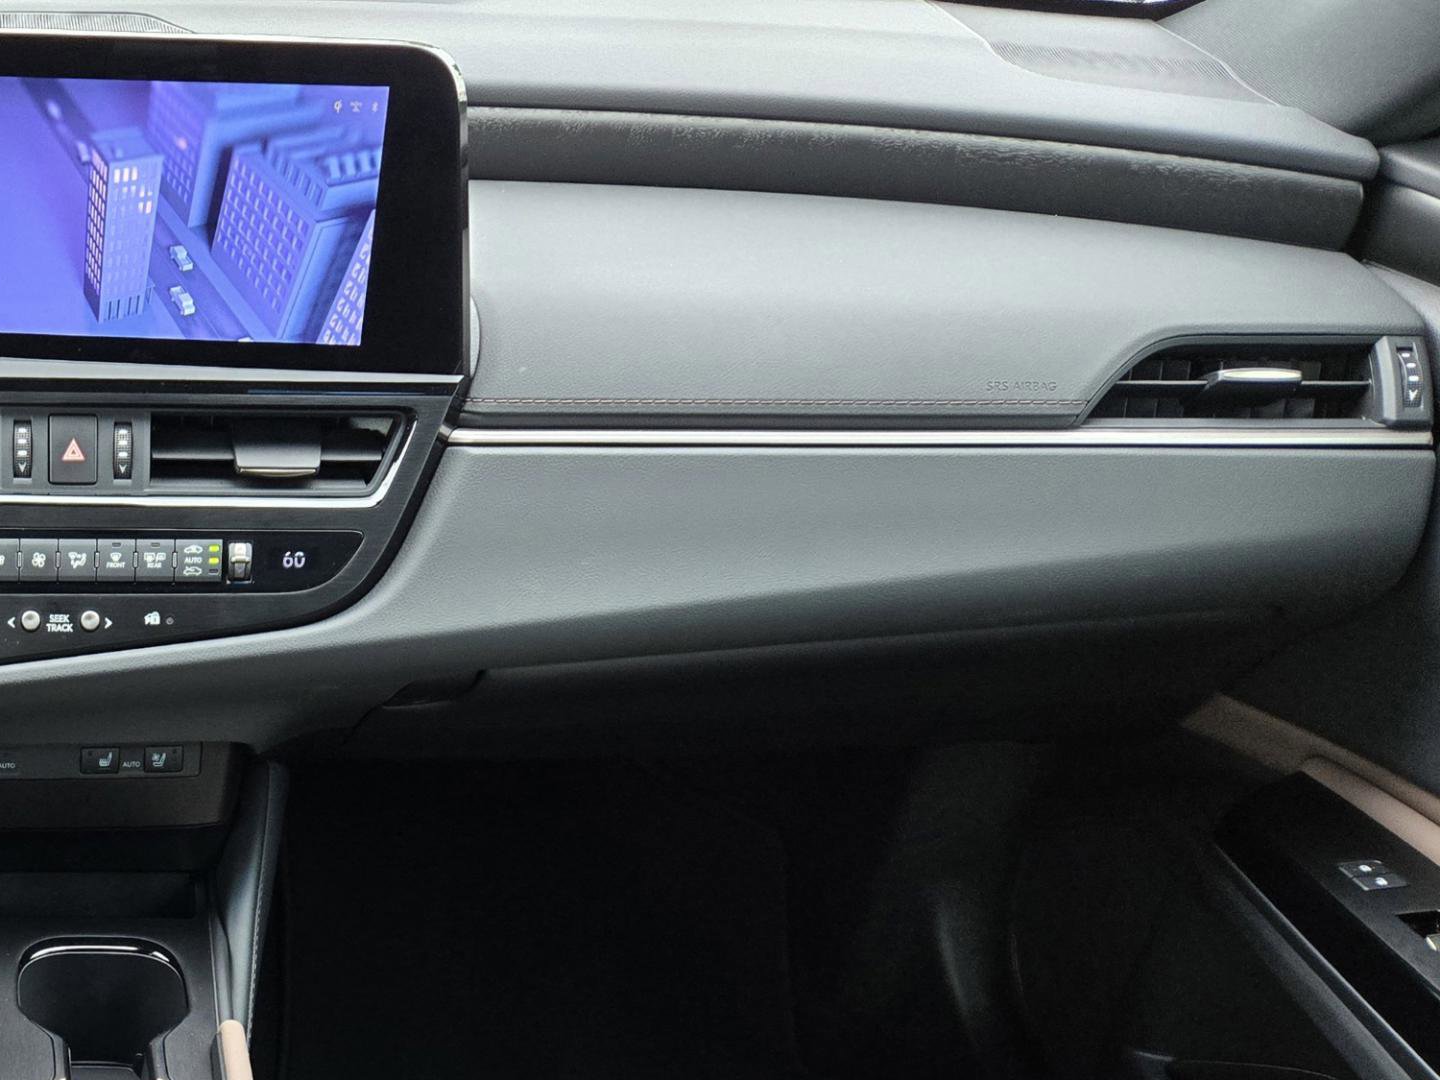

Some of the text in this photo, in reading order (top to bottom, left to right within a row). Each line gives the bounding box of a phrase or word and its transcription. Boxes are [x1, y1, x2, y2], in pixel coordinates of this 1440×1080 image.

[986, 381, 1008, 391] SRS
[184, 556, 202, 564] AUTO
[282, 551, 306, 569] 60
[49, 614, 70, 623] SEEK
[46, 623, 73, 632] TRACK
[122, 760, 140, 768] AUTO
